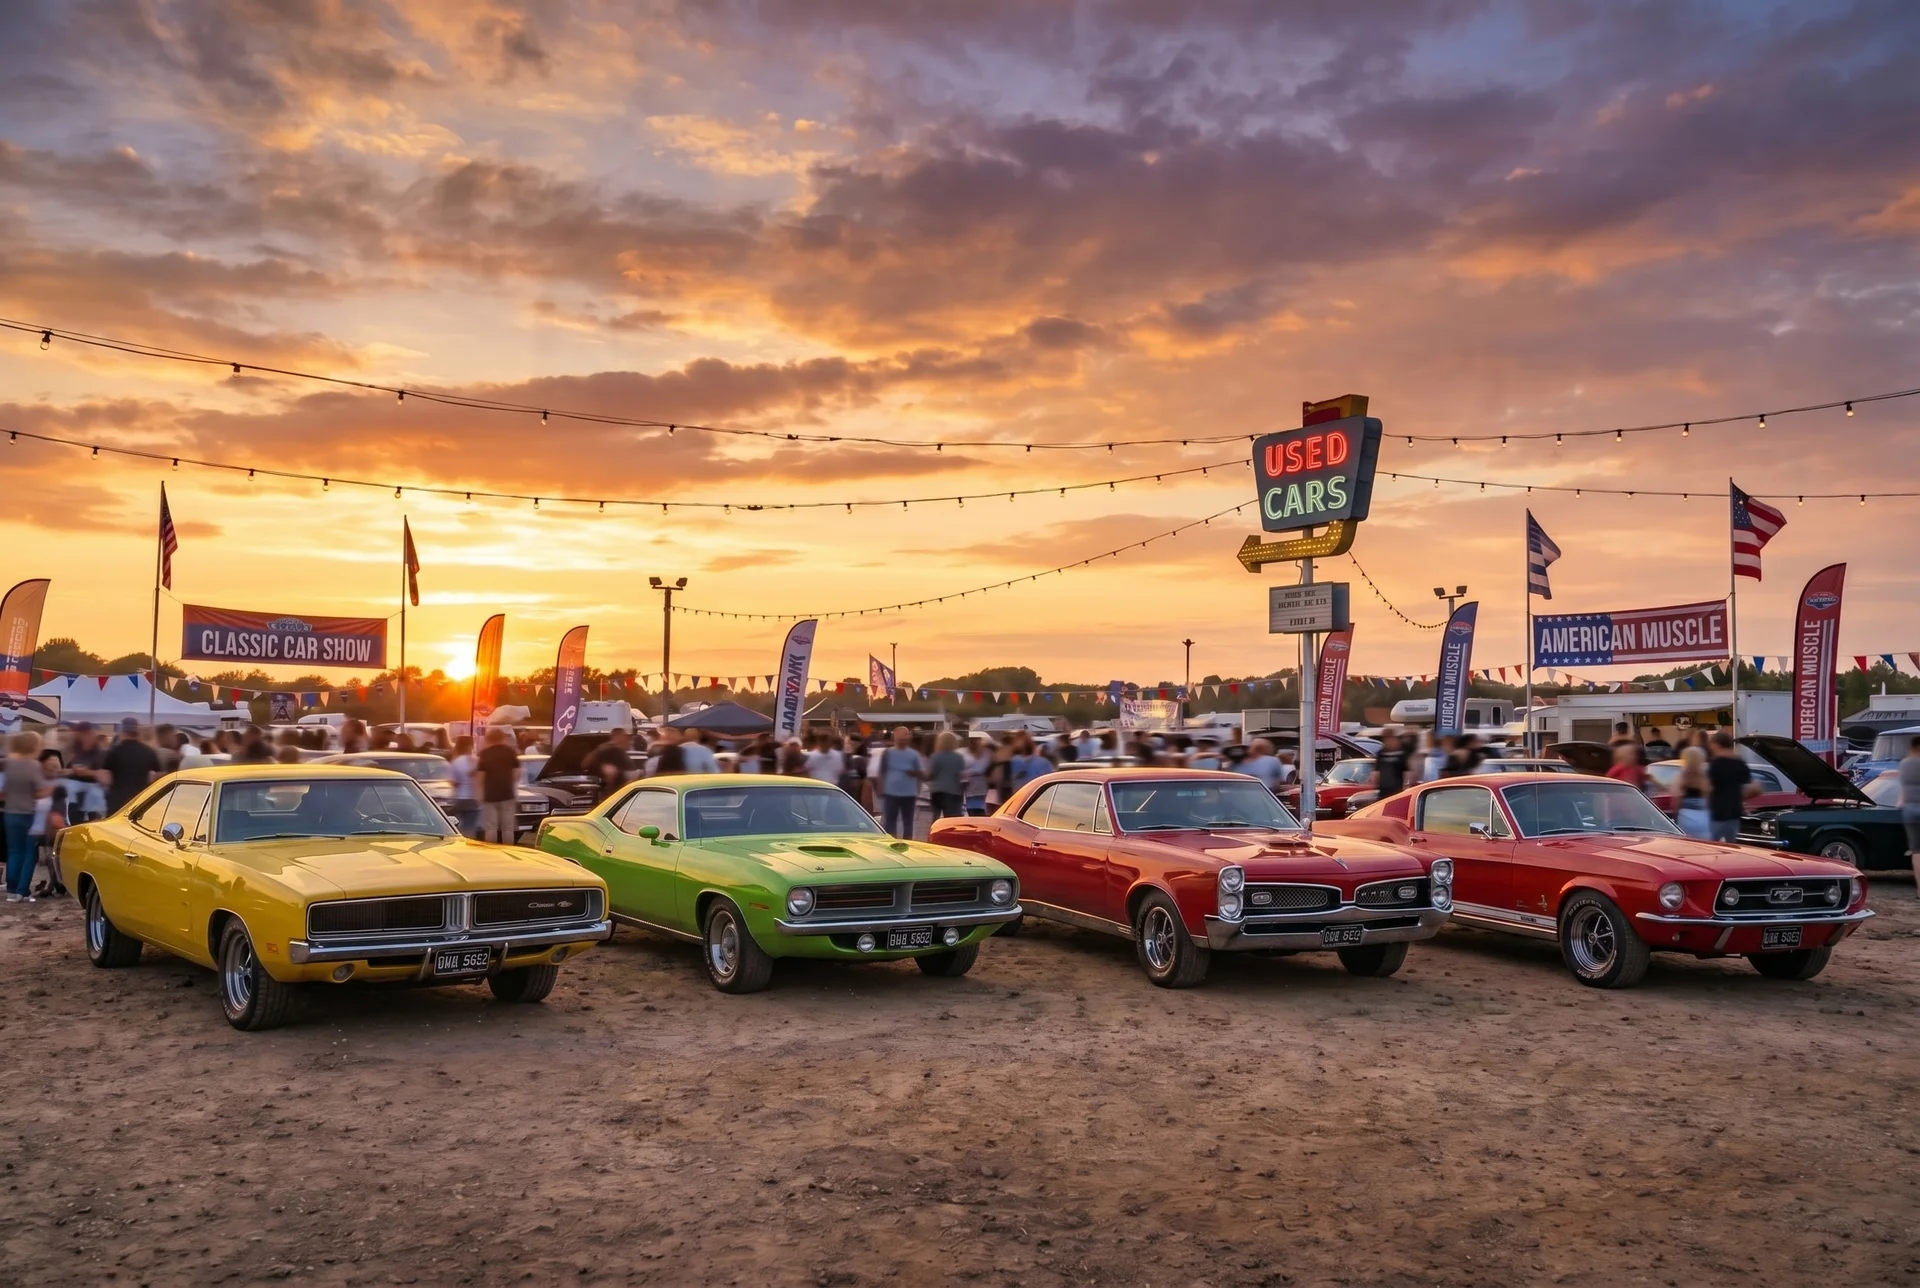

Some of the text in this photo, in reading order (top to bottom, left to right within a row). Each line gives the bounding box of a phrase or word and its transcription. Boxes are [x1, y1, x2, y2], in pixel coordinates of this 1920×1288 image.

[1265, 432, 1348, 477] USED
[1264, 475, 1347, 520] CARS
[201, 629, 371, 662] CLASSIC CAR SHOW
[1540, 615, 1722, 653] AMERICAN MUSCLE
[1802, 620, 1820, 676] MUSCLE
[1322, 657, 1337, 696] MUSCLE
[1444, 642, 1461, 685] MUSCLE
